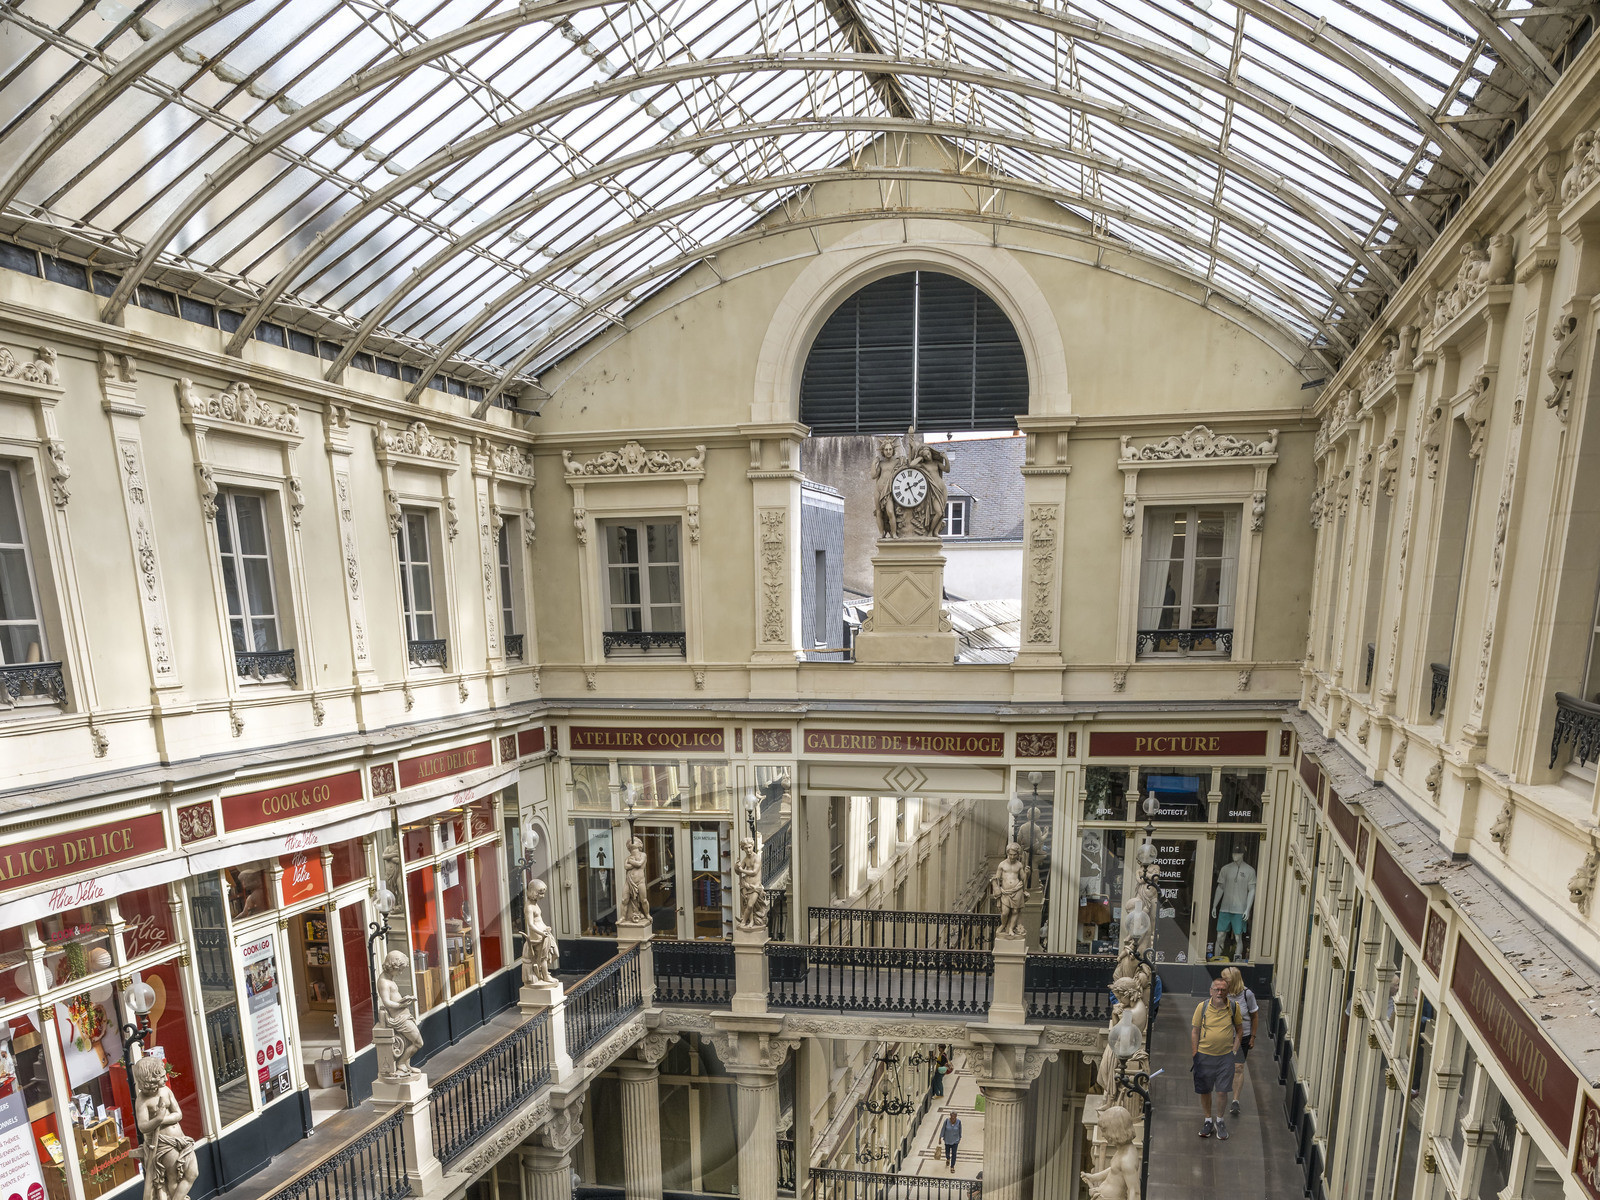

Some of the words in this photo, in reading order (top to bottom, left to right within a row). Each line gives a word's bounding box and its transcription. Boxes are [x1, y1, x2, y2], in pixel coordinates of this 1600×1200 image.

[573, 732, 645, 746] ATELIER
[647, 733, 722, 748] COQLICO
[807, 733, 877, 750] GALERIE
[881, 735, 902, 750] DE
[907, 736, 1001, 752] L'HORLOGE
[1135, 737, 1221, 752] PICTURE
[418, 756, 445, 778] ALICE
[446, 749, 478, 770] DELICE
[262, 791, 300, 815] COOK
[301, 789, 311, 806] &
[313, 784, 330, 803] GO
[62, 827, 134, 866] DELICE
[48, 886, 74, 911] Alice
[129, 914, 167, 940] Alice
[1470, 968, 1548, 1101] ECOUTERVOIR
